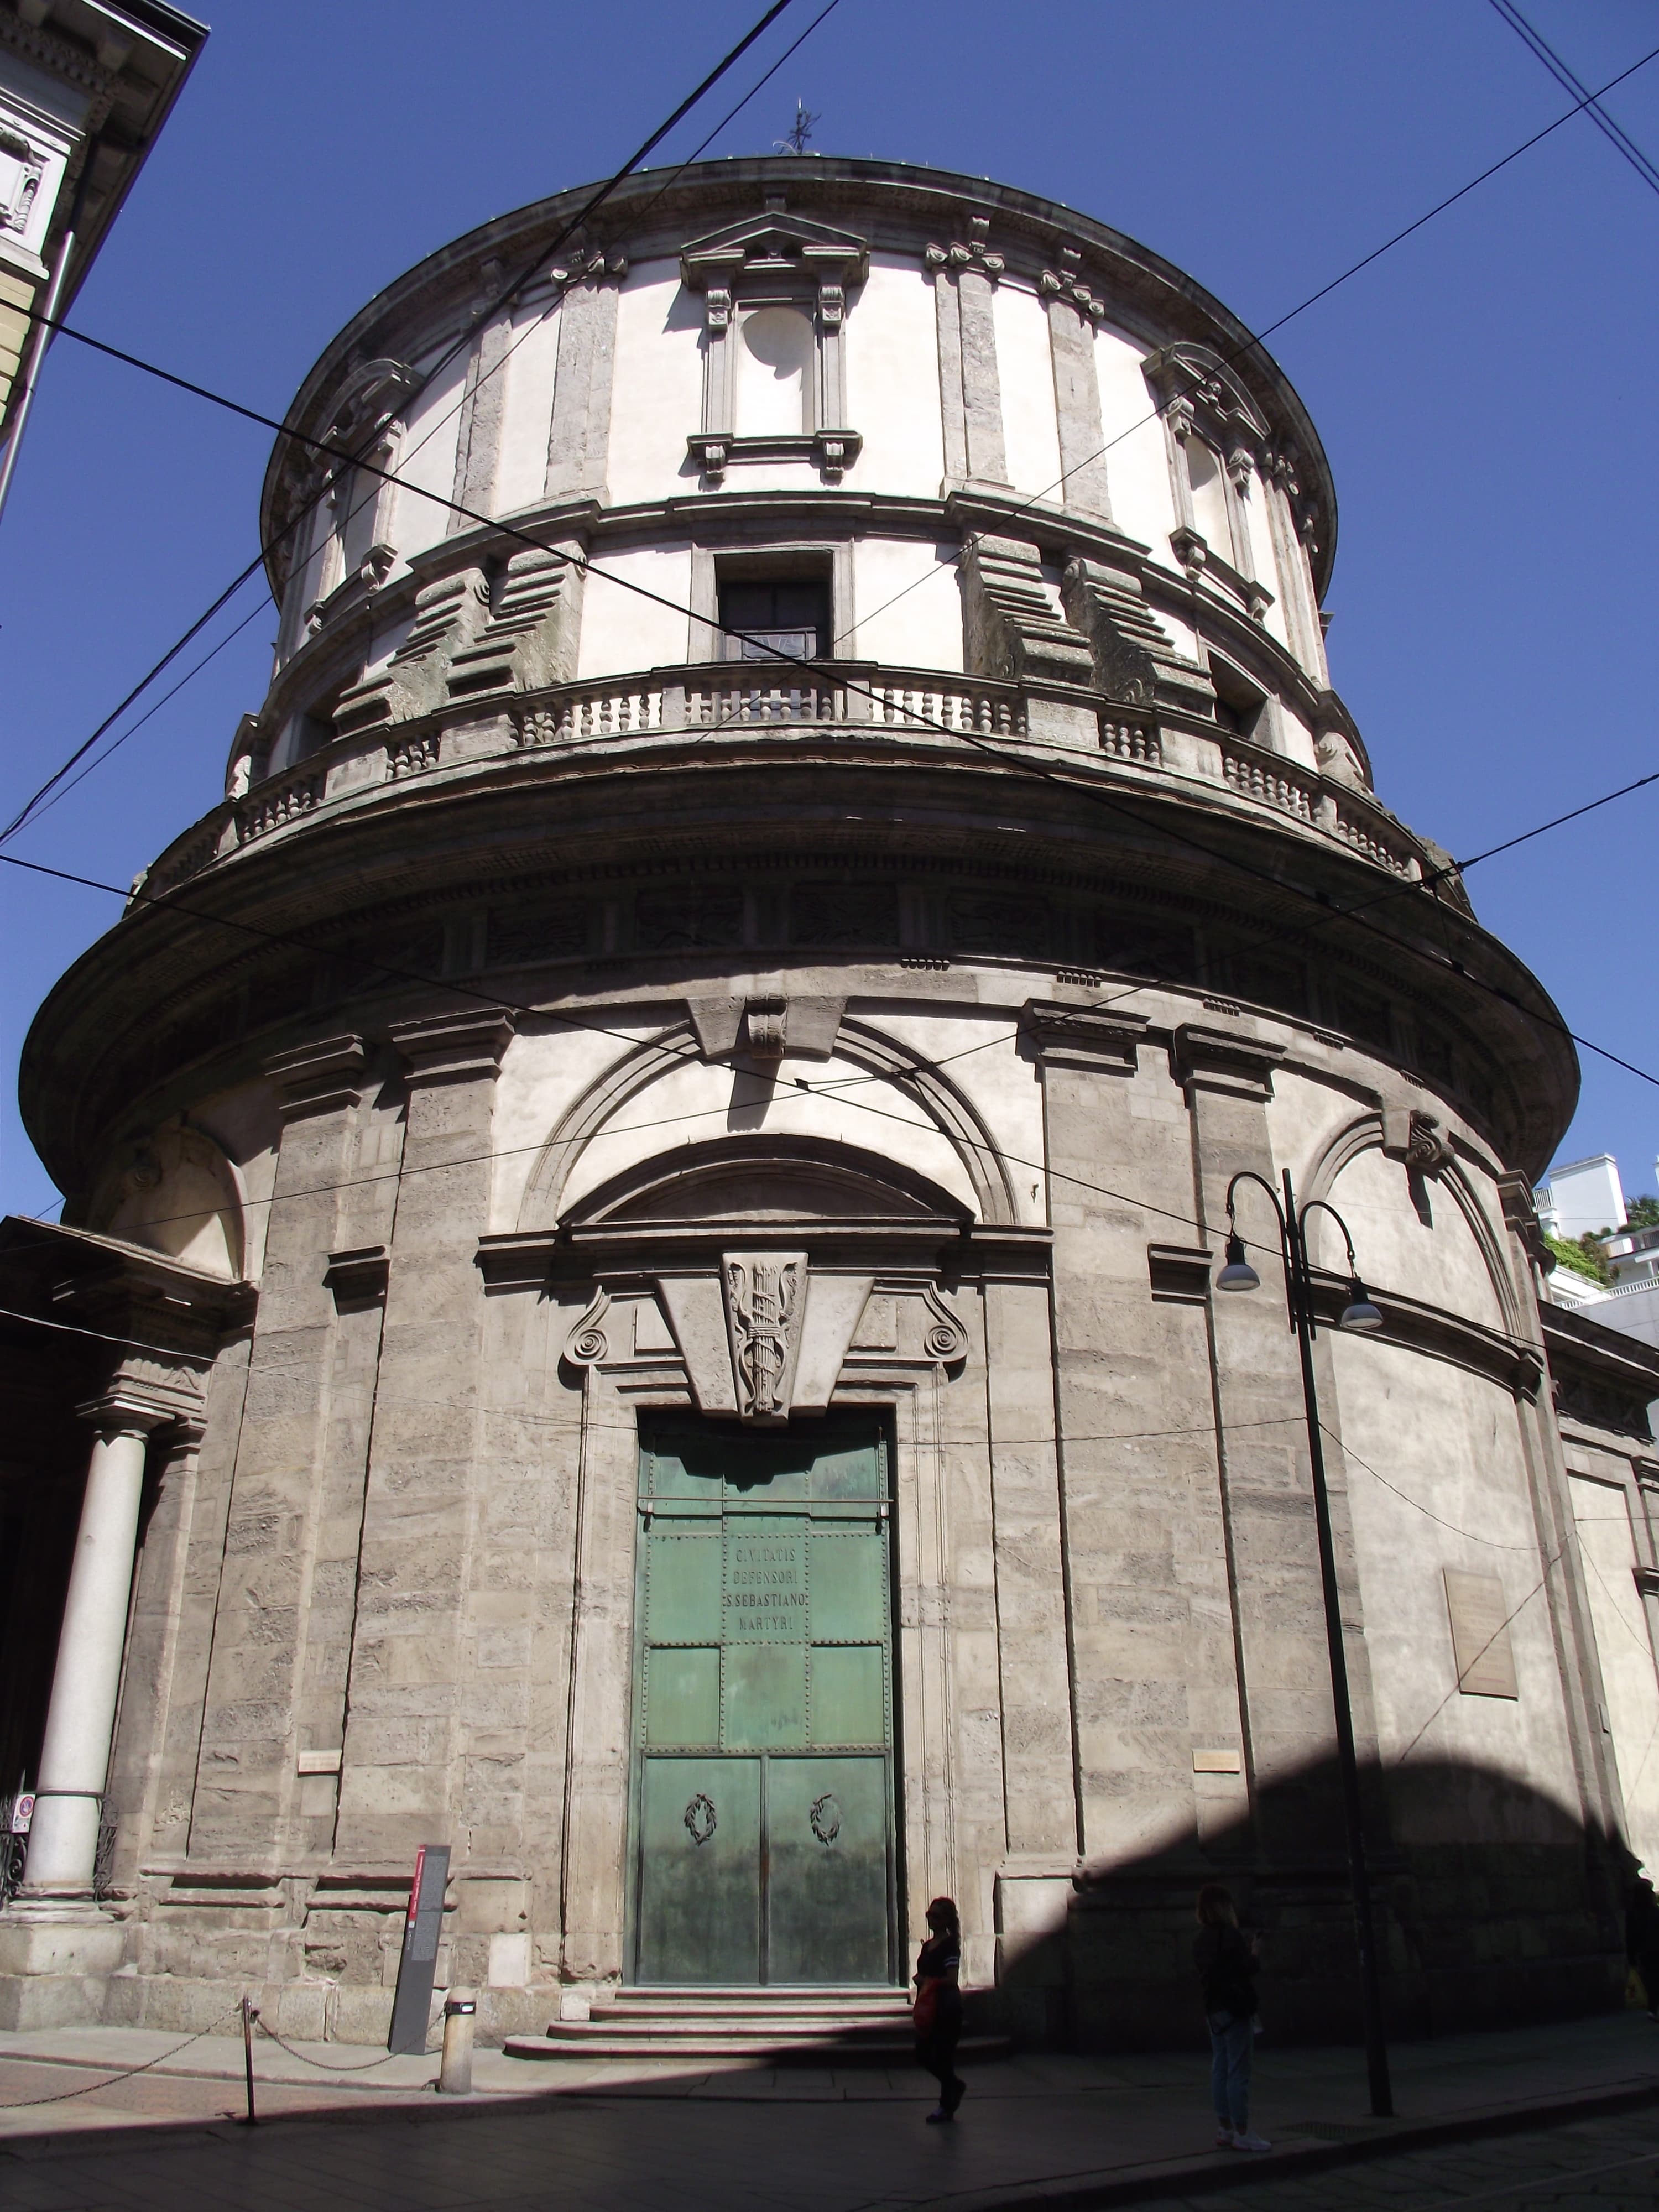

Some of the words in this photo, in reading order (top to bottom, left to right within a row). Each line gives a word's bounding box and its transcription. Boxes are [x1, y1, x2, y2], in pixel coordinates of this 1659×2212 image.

[736, 1548, 795, 1562] CIVITATIS
[734, 1571, 797, 1584] DEFENSORI
[739, 1616, 792, 1630] MARTYRI
